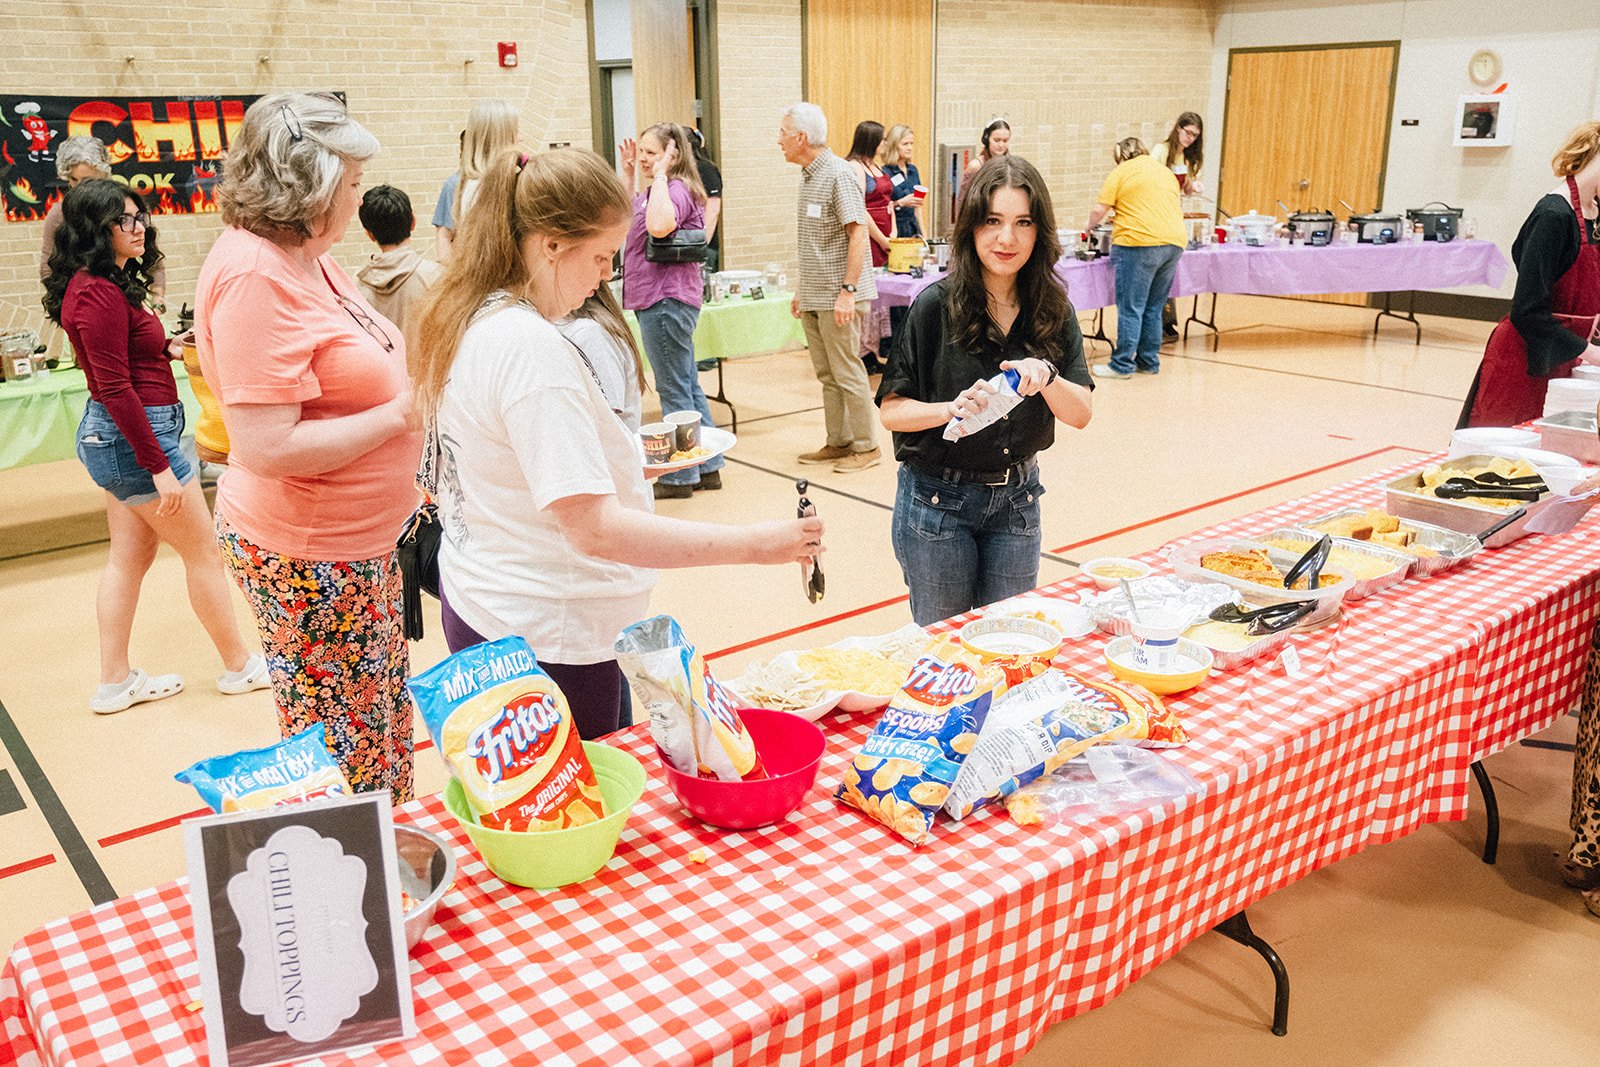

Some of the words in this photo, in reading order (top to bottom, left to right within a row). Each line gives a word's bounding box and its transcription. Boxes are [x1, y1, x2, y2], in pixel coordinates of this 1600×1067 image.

[442, 671, 480, 703] MIX
[490, 650, 535, 682] MATCH
[901, 655, 977, 696] Fritos
[466, 693, 562, 784] Fritos
[864, 739, 894, 760] arty
[1041, 738, 1054, 755] DIP
[518, 800, 537, 819] The
[535, 757, 583, 808] ORIGINAL
[267, 851, 293, 910] CHILI
[274, 909, 307, 1024] TOPPINGS
